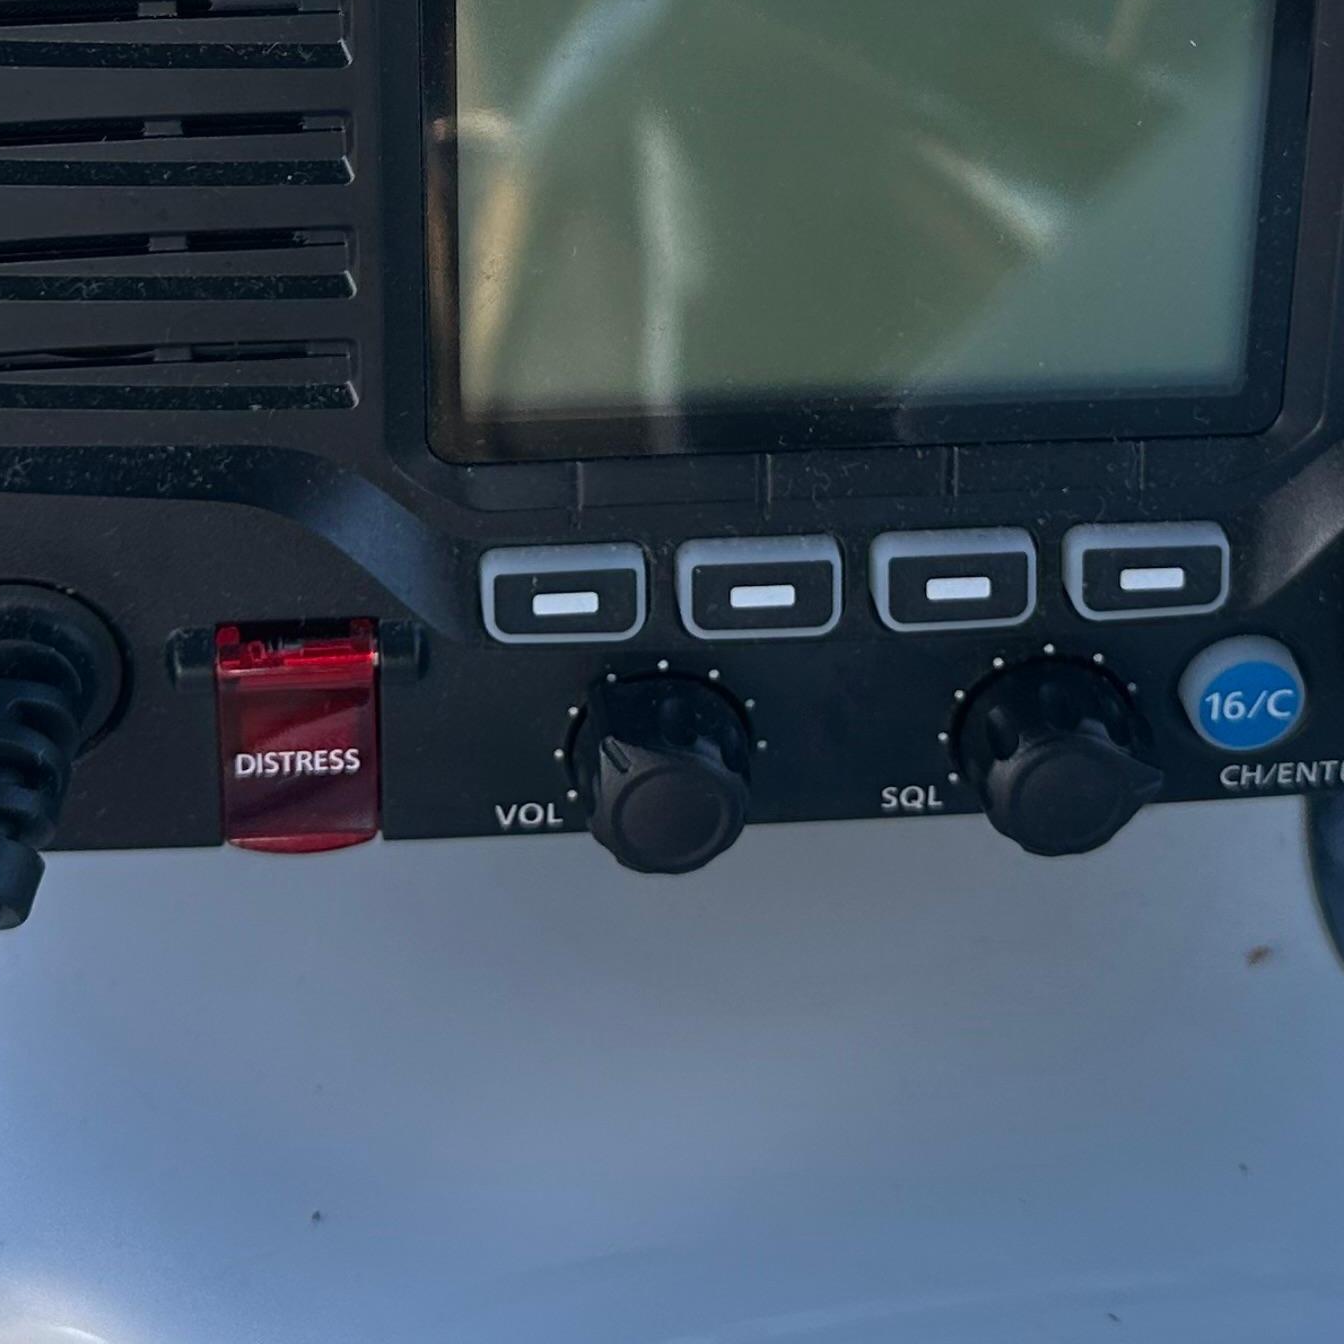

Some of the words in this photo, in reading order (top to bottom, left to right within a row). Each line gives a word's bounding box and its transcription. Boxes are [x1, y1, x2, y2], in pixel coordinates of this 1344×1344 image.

[1204, 690, 1295, 721] 16/C
[234, 747, 360, 776] DISTRESS
[1219, 760, 1338, 786] CH/ENT
[880, 784, 943, 810] SQL
[495, 802, 563, 828] VOL
